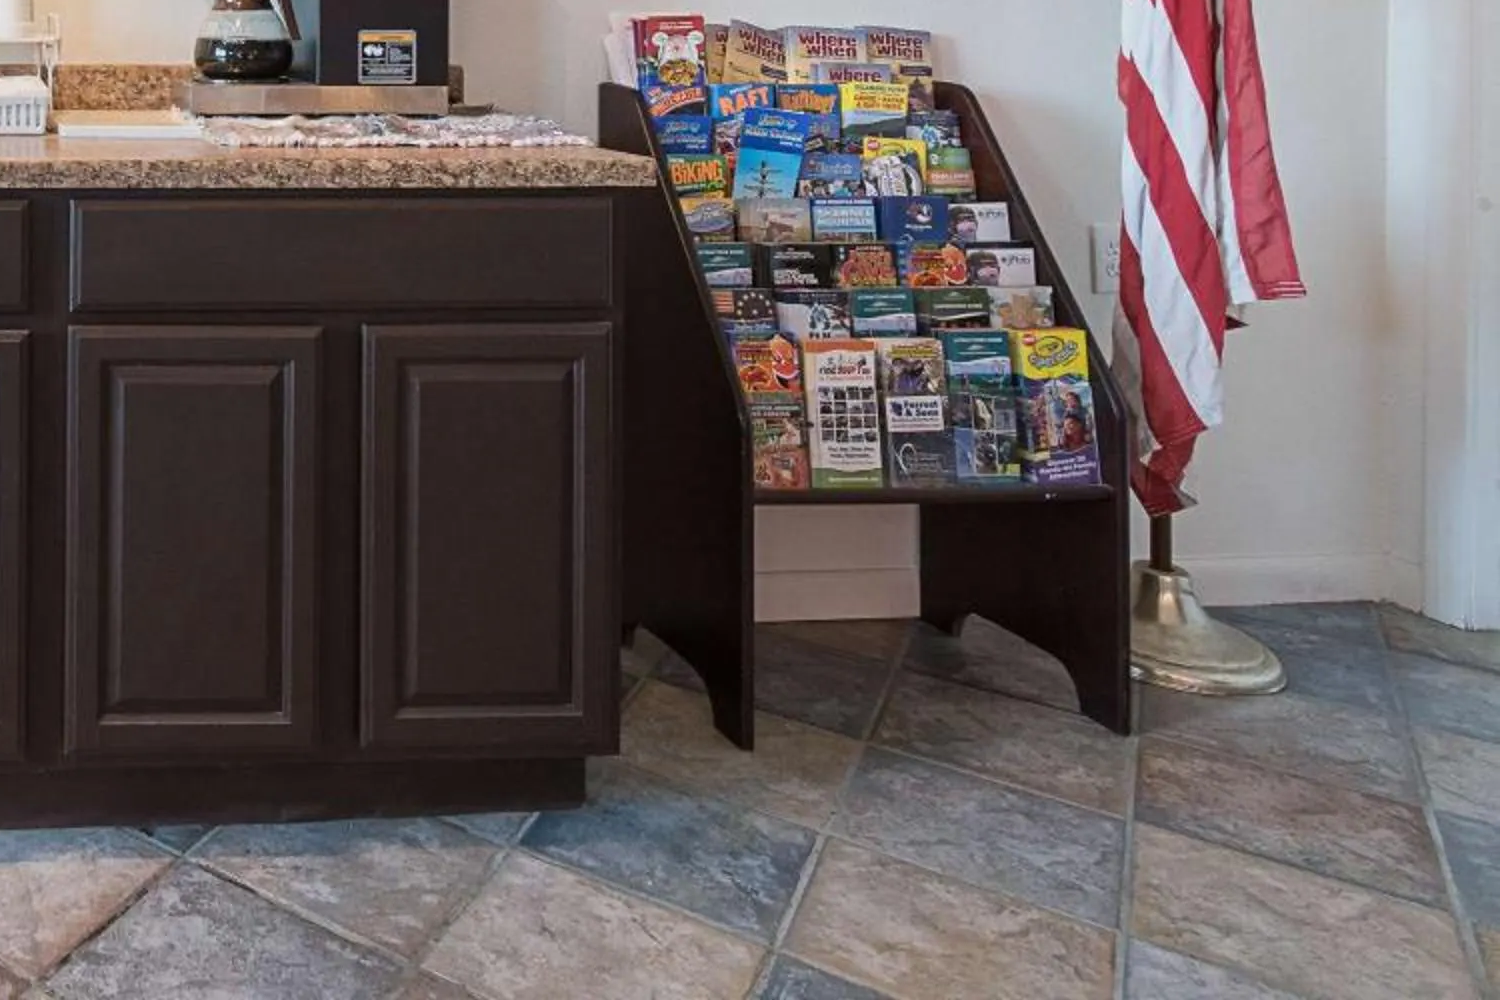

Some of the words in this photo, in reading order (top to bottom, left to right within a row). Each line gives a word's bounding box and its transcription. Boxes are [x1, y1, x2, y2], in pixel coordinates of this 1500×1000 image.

[799, 32, 857, 47] where
[870, 32, 923, 48] where
[811, 45, 857, 58] when
[880, 45, 924, 60] when
[829, 67, 881, 82] where
[720, 86, 769, 116] RAFT
